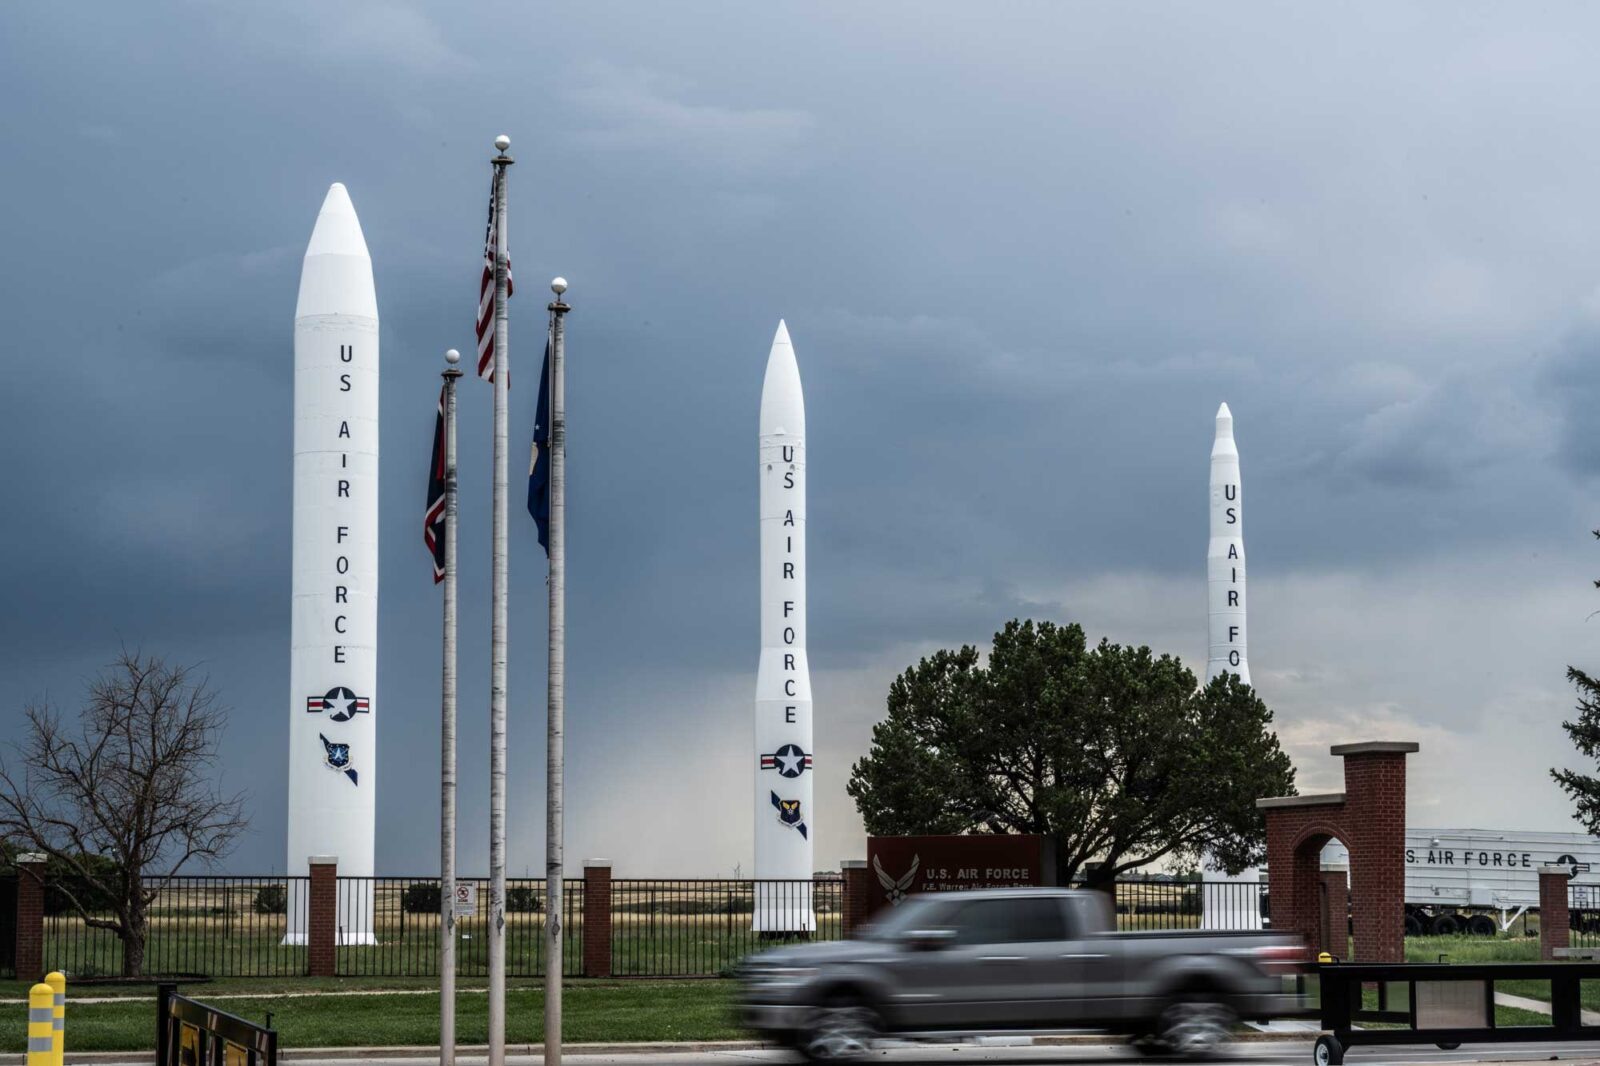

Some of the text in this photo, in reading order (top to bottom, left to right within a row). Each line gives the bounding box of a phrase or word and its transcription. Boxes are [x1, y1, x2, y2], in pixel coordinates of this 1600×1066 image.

[333, 344, 353, 664] US AIR FORCE
[1224, 484, 1237, 525] US
[782, 445, 796, 724] US AIR FORCE
[1227, 543, 1239, 607] AIR
[926, 868, 1030, 880] U.S. AIR FORCE
[1427, 850, 1455, 865] AIR
[1464, 851, 1532, 868] FORCE
[922, 883, 937, 891] F.E.
[939, 883, 970, 891] Warren
